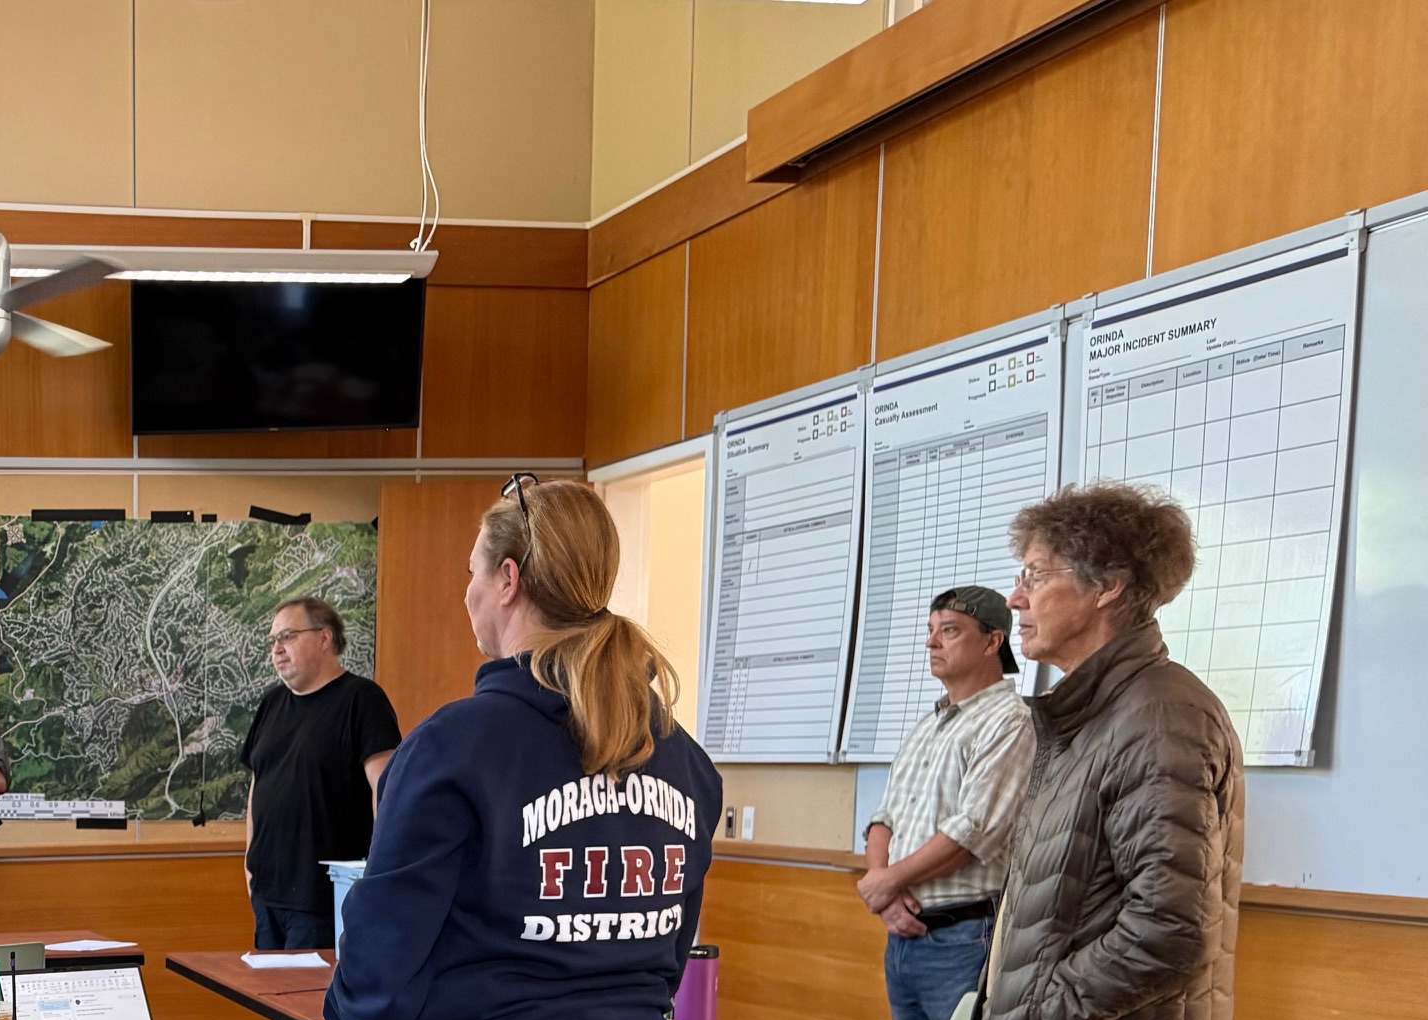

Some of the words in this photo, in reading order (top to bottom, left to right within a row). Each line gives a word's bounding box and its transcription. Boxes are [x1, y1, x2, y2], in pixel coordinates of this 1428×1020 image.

[1089, 345, 1120, 361] MAJOR
[1123, 332, 1166, 353] INCIDENT
[1168, 318, 1217, 340] SUMMARY
[1090, 329, 1124, 347] ORINDA
[1141, 379, 1164, 389] Description
[1183, 370, 1202, 378] Location
[875, 401, 899, 415] ORINDA
[875, 413, 900, 427] Casualty
[901, 402, 938, 419] Assessment
[748, 443, 770, 454] Summary
[523, 773, 696, 848] MORAGA-ORINDA
[539, 844, 685, 900] FIRE
[520, 903, 682, 942] DISTRICT
